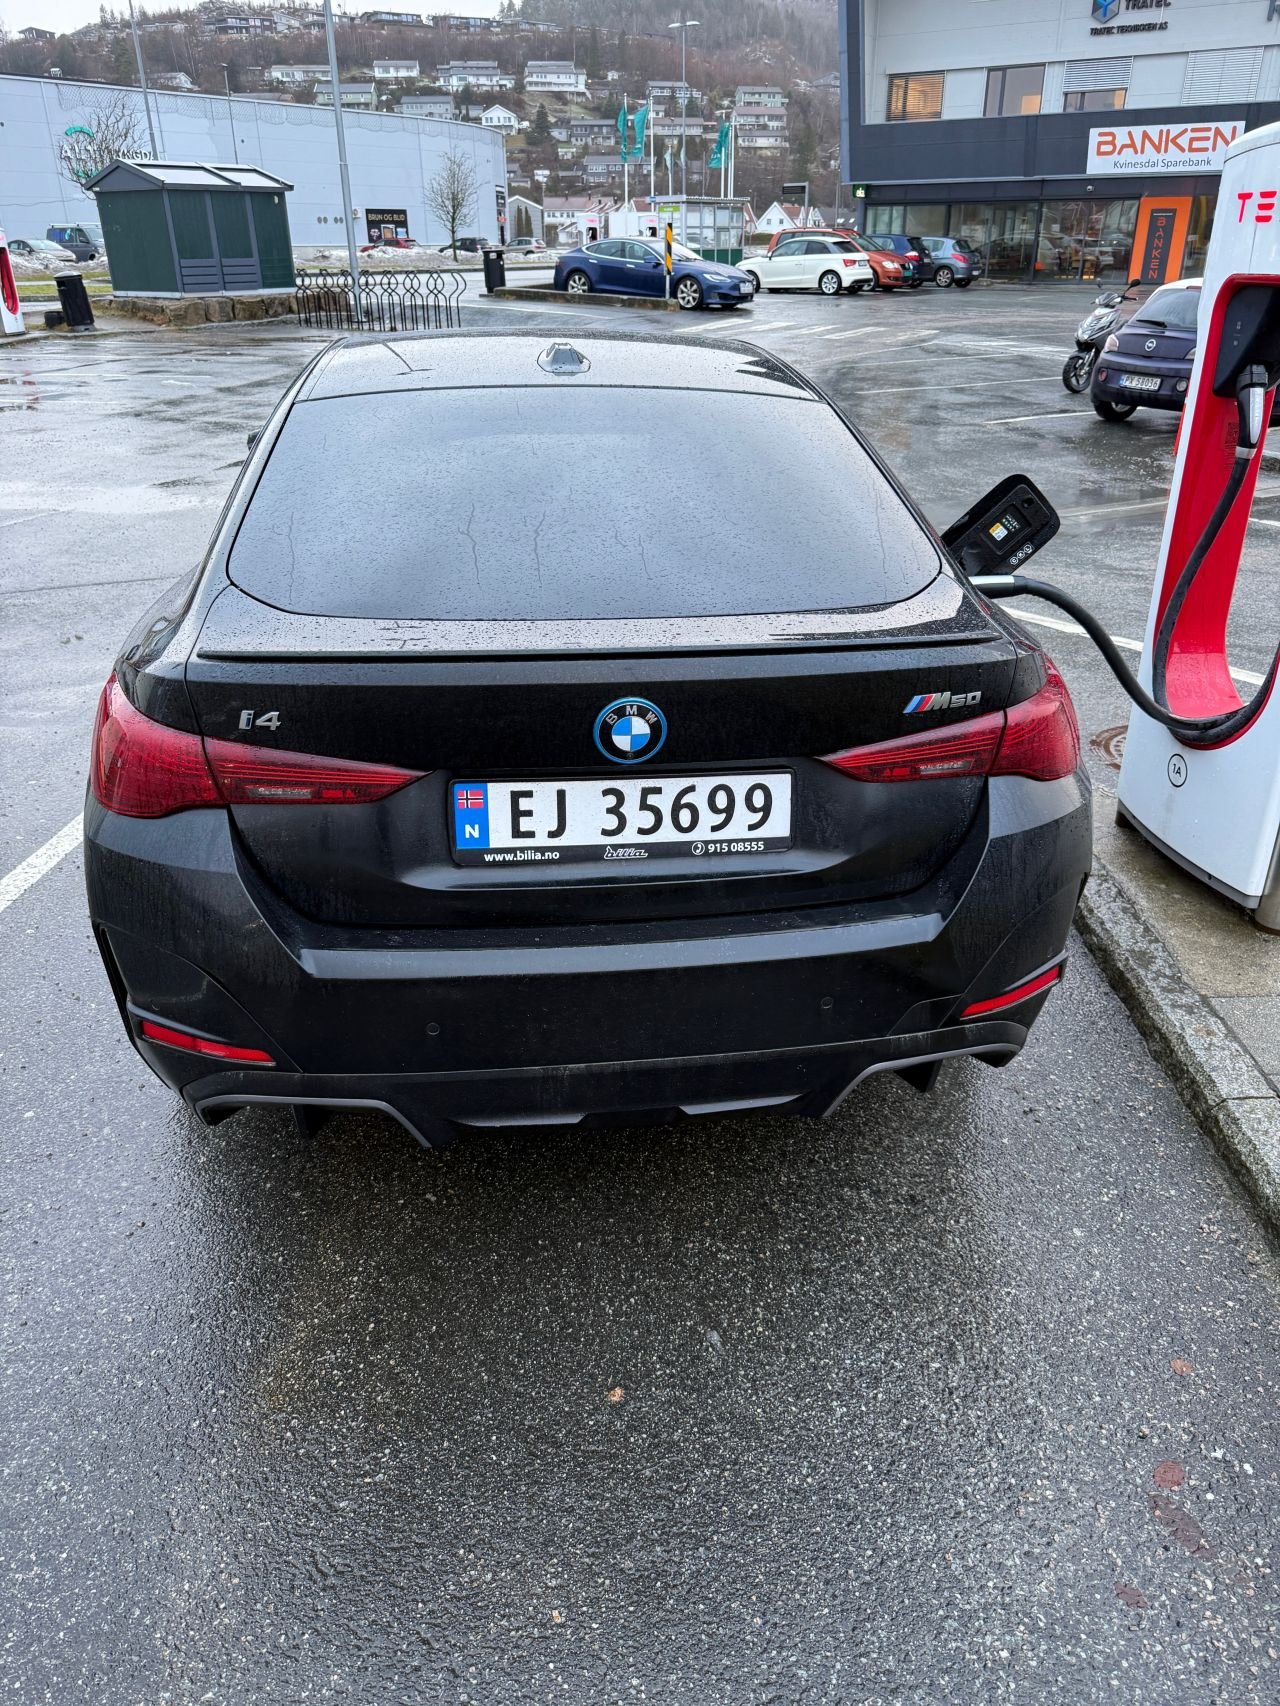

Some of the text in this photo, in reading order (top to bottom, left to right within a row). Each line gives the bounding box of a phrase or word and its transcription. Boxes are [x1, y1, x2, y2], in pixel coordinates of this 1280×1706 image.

[1158, 21, 1168, 31] AS
[1096, 125, 1237, 157] BANKEN
[1113, 156, 1212, 170] Kvinesdal Sparebank
[368, 213, 383, 221] BRUN
[1148, 216, 1166, 280] BANKEN
[239, 710, 282, 731] i4
[605, 704, 658, 726] BMW
[1172, 763, 1182, 778] 1A
[510, 782, 773, 839] EJ 35699
[464, 823, 480, 839] N
[708, 841, 765, 853] 915 08555
[483, 850, 560, 862] www.bilia.no
